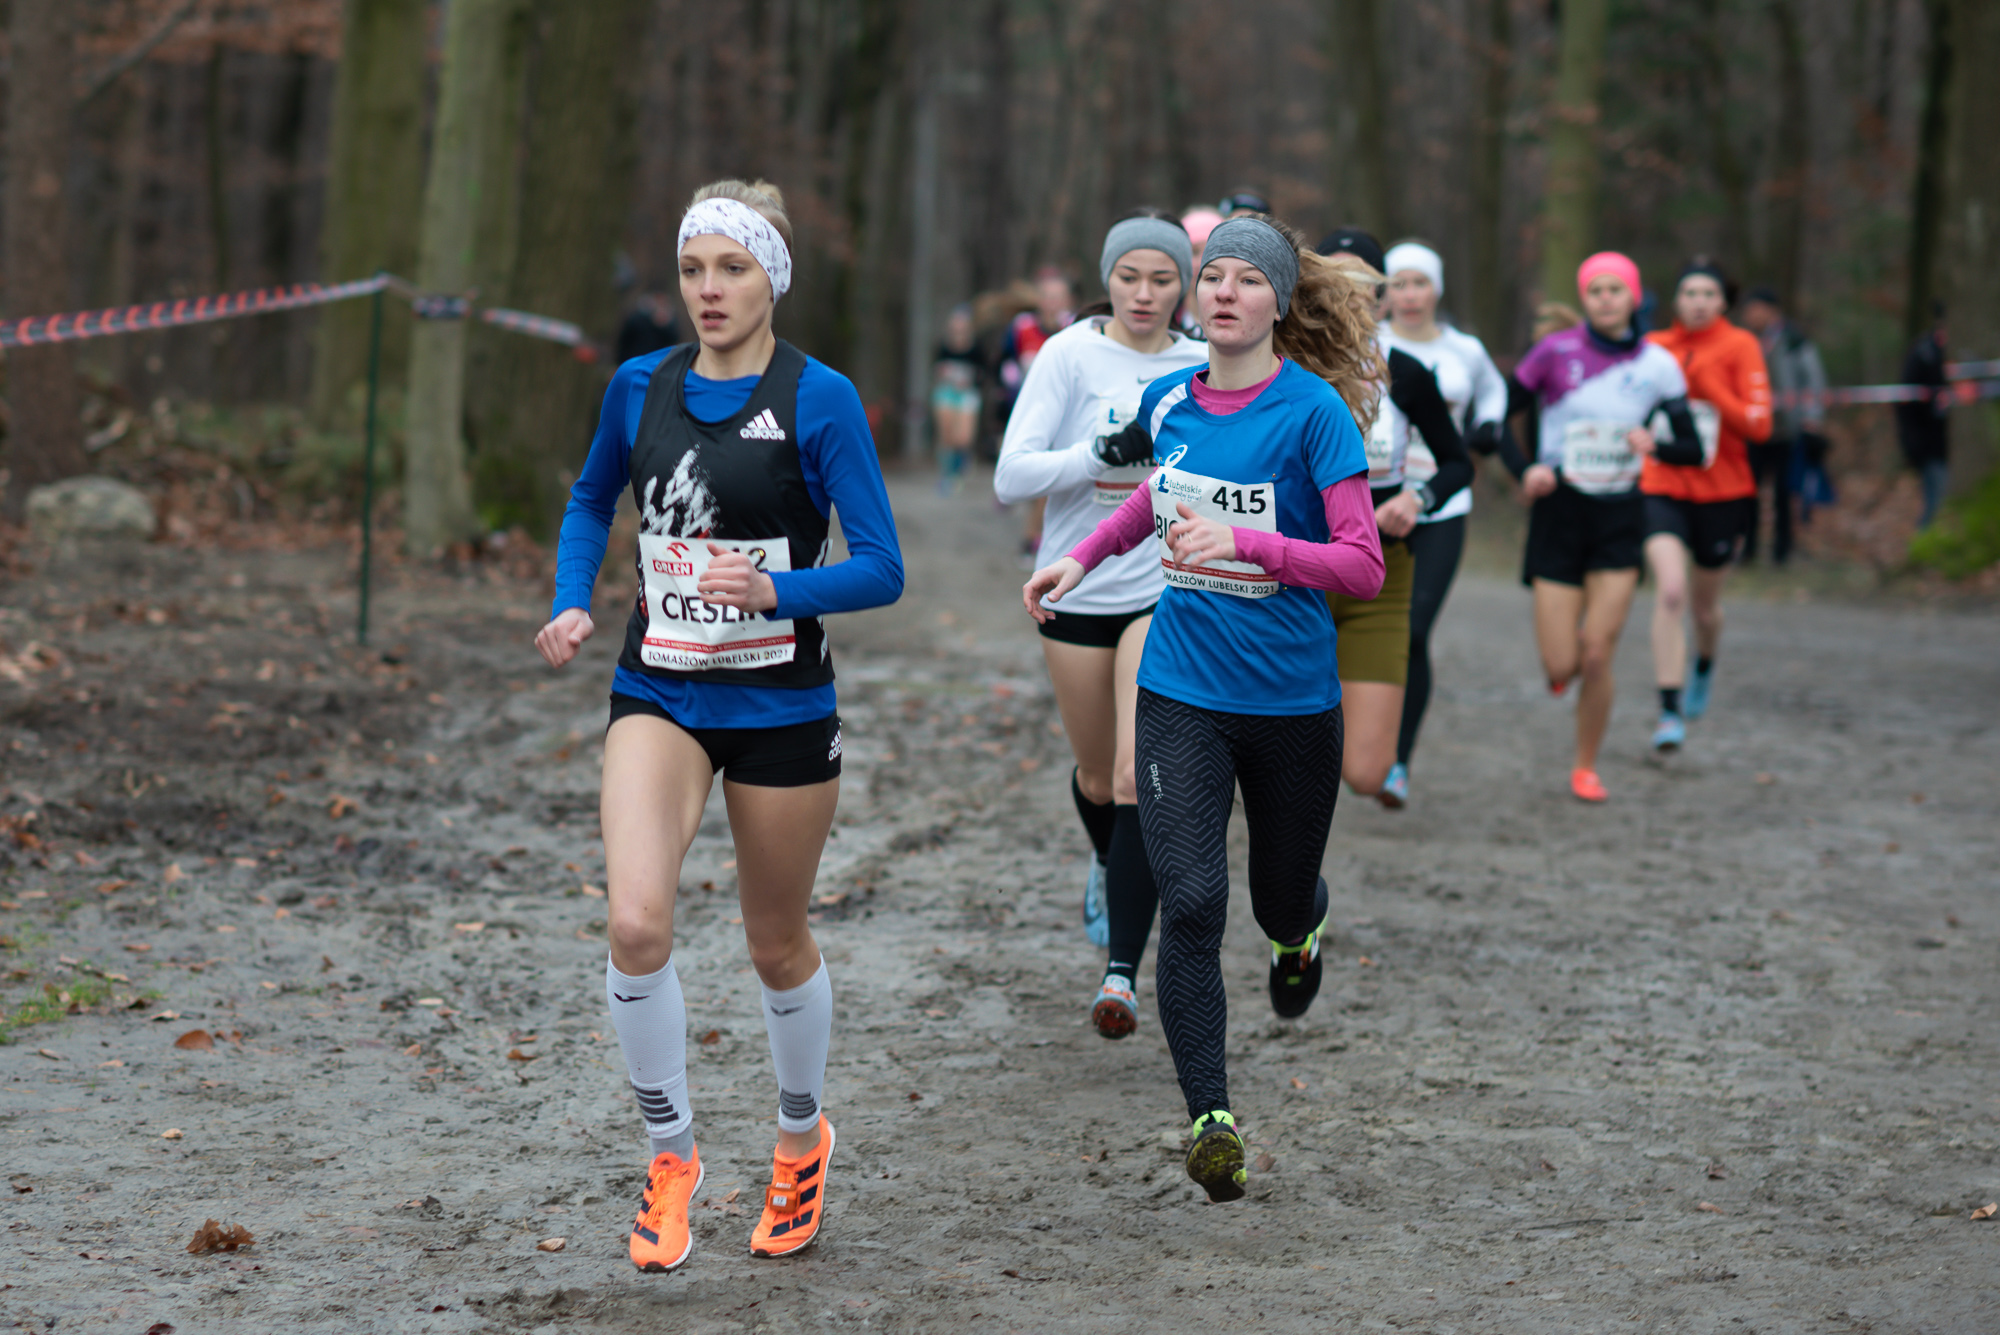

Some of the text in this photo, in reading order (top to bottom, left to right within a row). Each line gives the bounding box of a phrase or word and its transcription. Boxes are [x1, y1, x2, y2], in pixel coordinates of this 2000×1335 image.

[740, 427, 786, 441] adidas
[1169, 479, 1203, 495] lubelskie
[1212, 486, 1266, 514] 415
[654, 561, 691, 576] ORLEN
[1162, 569, 1274, 595] MASZÓW LUBELSKI 2021
[648, 648, 788, 667] TOMASZÓW LUBELSKI 2021
[1150, 763, 1162, 793] CRAFT
